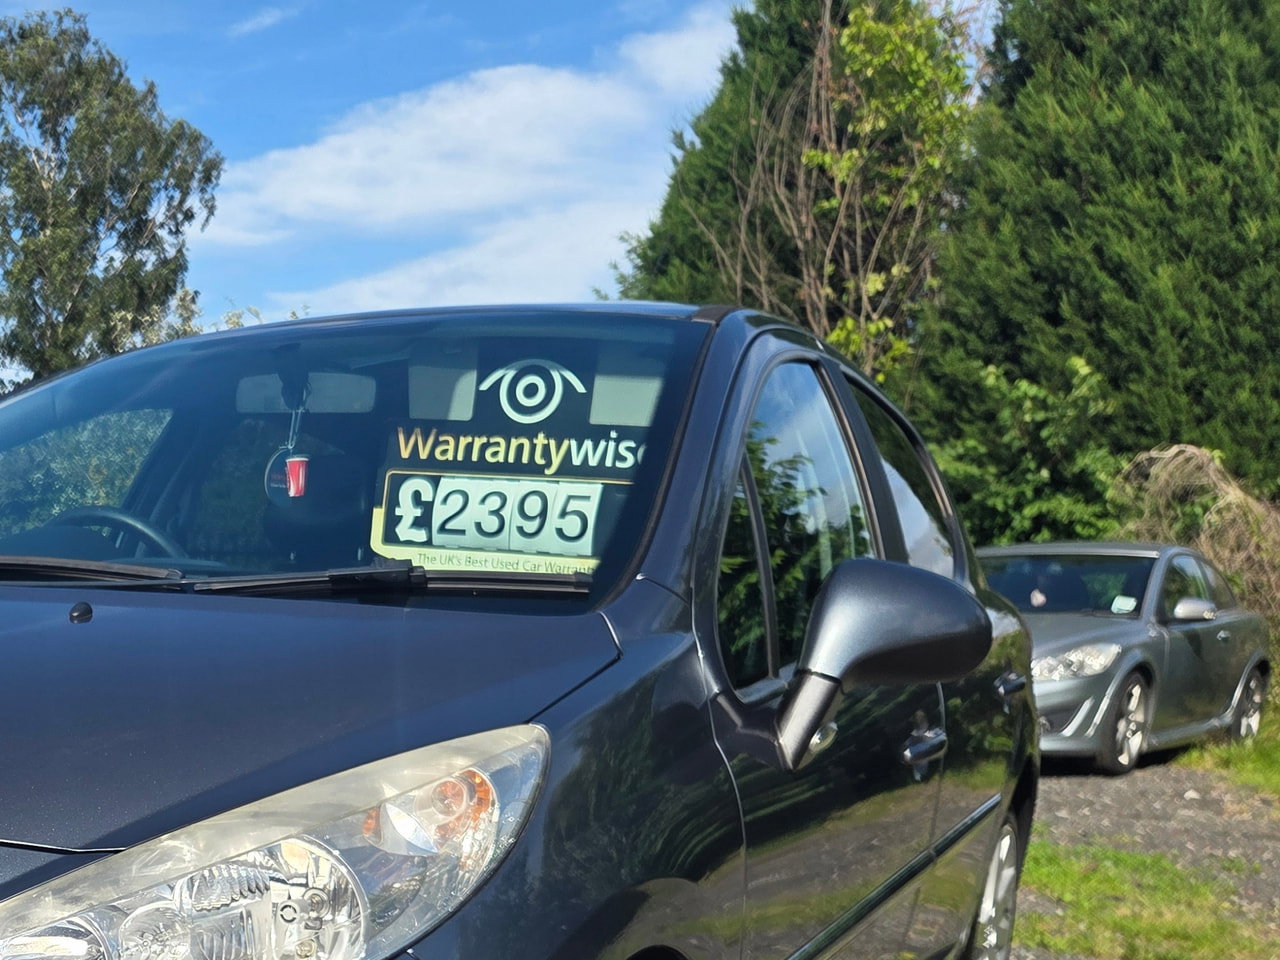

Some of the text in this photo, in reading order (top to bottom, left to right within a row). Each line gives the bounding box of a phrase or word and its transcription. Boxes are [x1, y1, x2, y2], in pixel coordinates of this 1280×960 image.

[394, 477, 592, 543] £2395
[417, 552, 437, 565] The
[439, 553, 461, 566] UK's
[464, 555, 490, 568] Best
[491, 557, 520, 571] Used
[522, 560, 543, 572] Car
